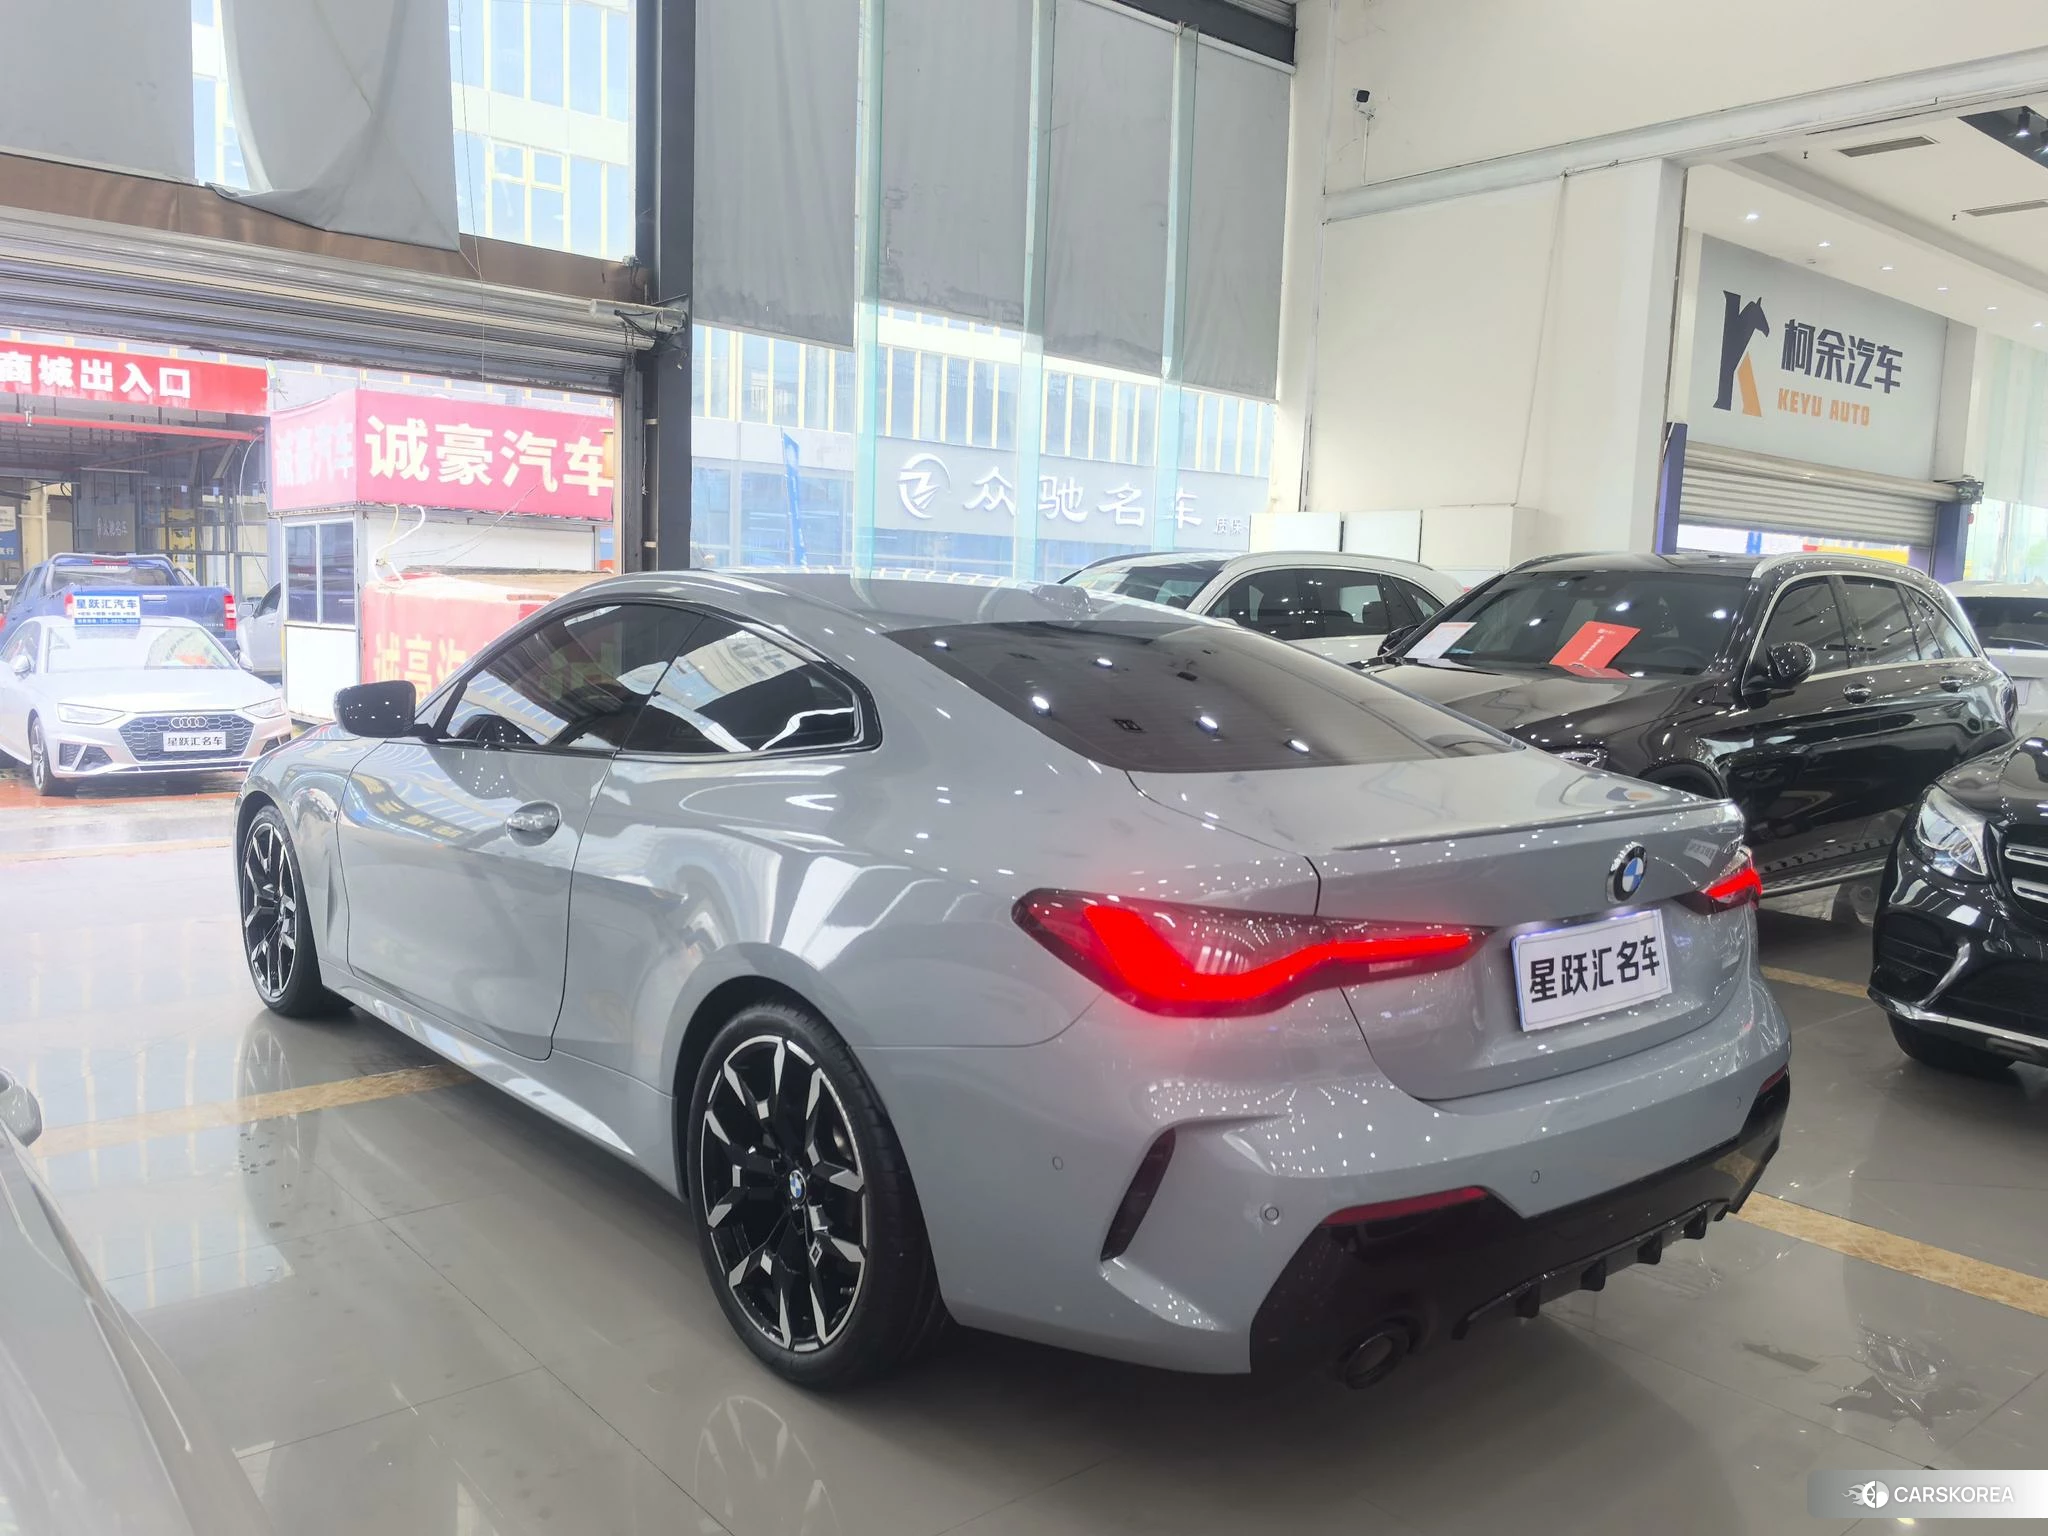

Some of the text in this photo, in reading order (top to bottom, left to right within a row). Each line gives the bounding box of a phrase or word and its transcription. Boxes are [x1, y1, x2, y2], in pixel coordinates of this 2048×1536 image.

[0, 351, 191, 399] 商城出入口
[1781, 319, 1903, 394] 柯余汽车
[1777, 387, 1870, 427] KEYU AUTO
[364, 415, 613, 497] 诚豪汽车
[963, 466, 1203, 529] 众驰名车
[1530, 935, 1660, 1003] 星跃汇名车
